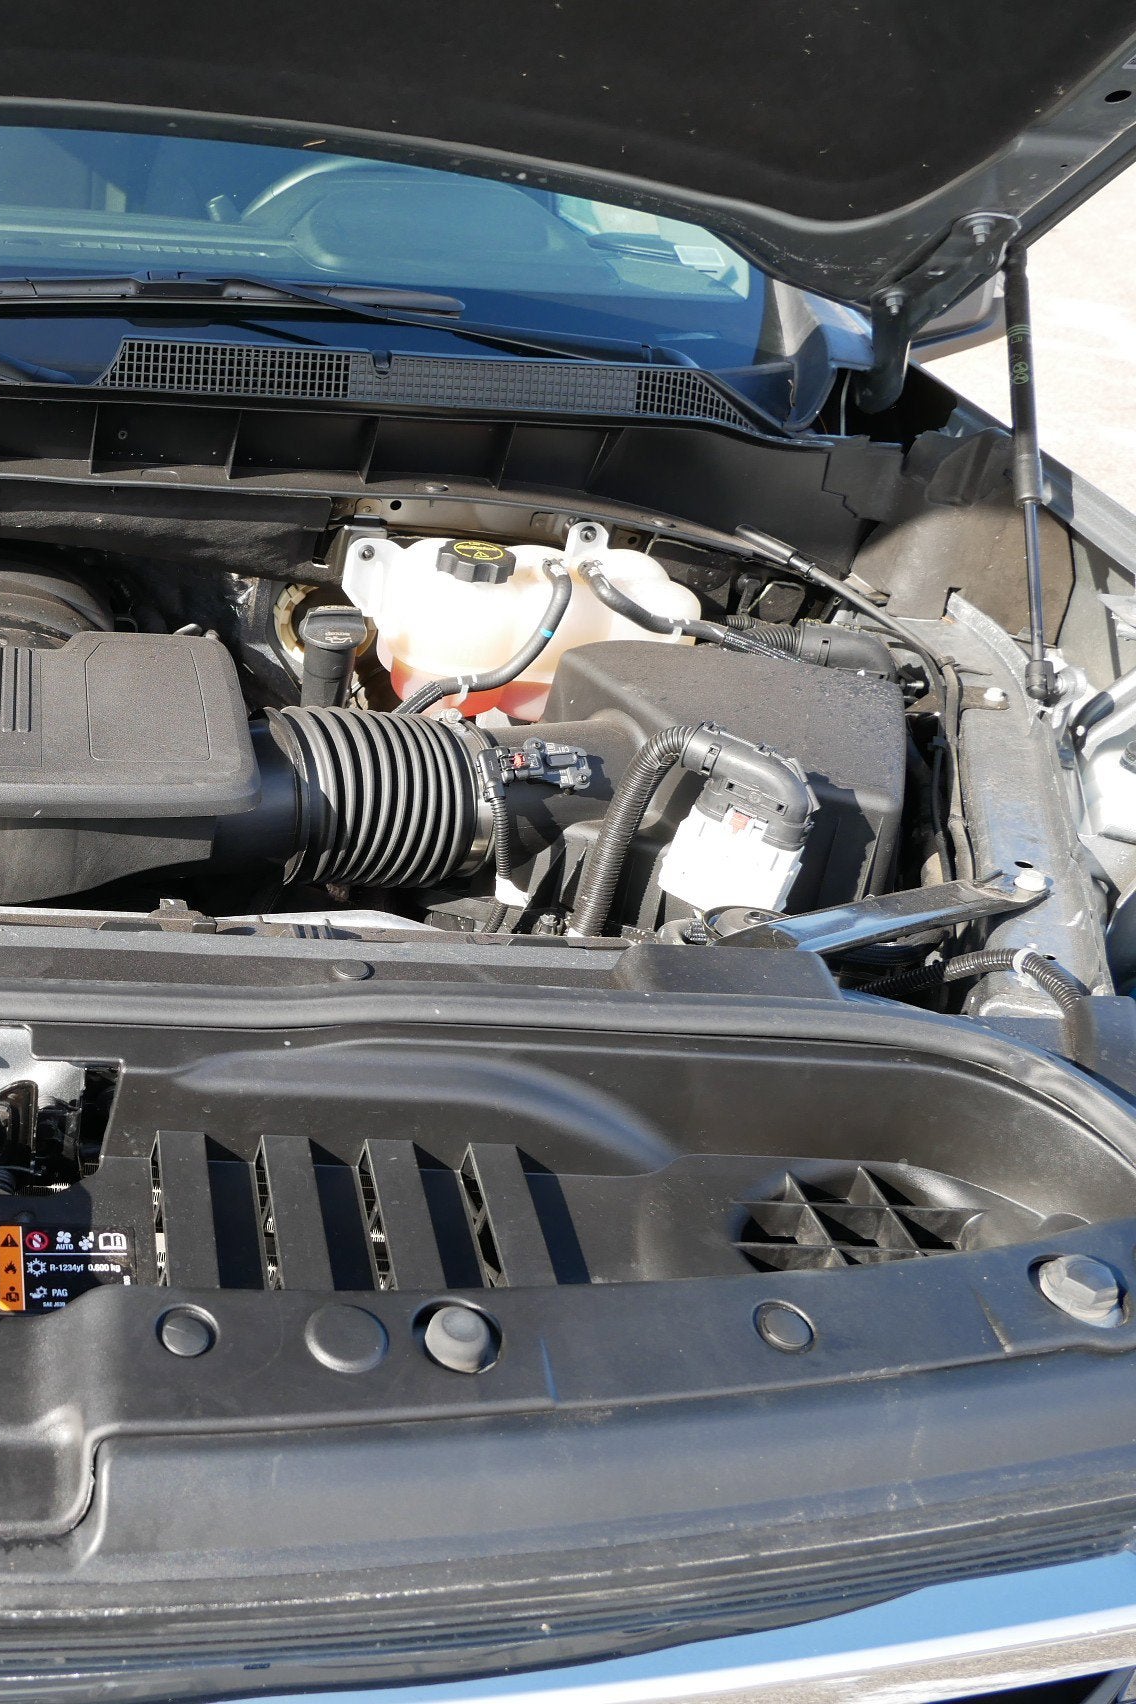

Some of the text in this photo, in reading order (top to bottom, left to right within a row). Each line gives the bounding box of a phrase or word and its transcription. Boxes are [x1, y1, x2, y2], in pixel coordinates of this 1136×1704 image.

[49, 1263, 84, 1273] R-1234yf
[110, 1263, 121, 1273] kg
[51, 1288, 68, 1297] PAG
